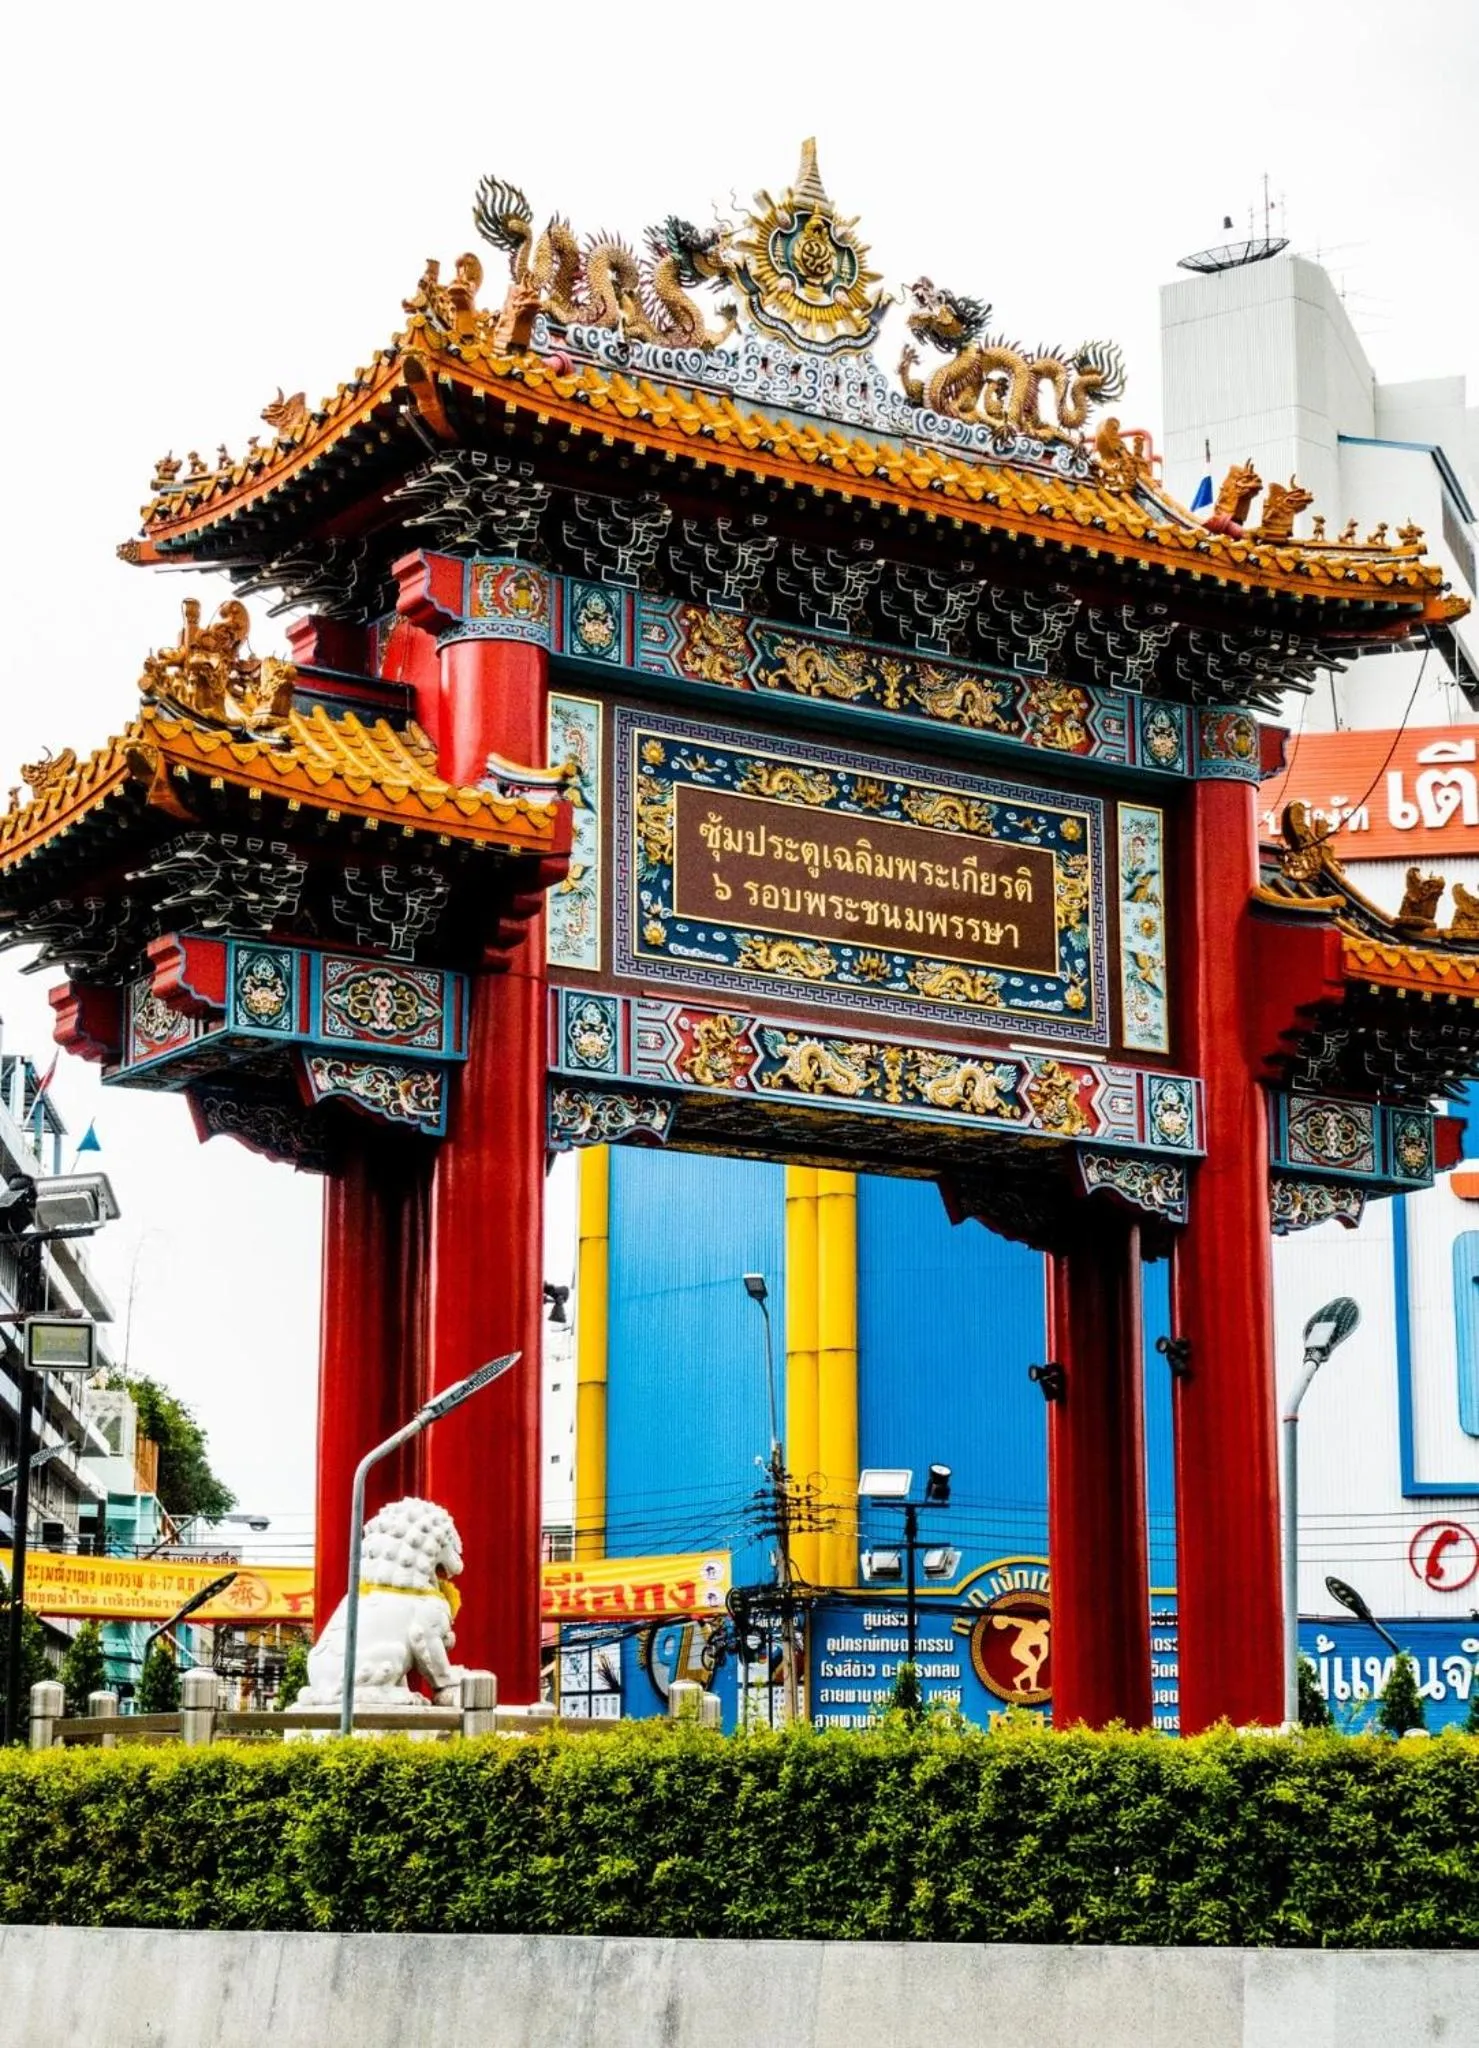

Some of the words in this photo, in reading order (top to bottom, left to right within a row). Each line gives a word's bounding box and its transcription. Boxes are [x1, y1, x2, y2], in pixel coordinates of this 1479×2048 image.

[699, 811, 1034, 904] ซุ้มประตูเฉลิมพระเกียรติ
[712, 873, 732, 902] ๖
[743, 880, 1020, 950] รอบพระชนมพรรษา
[826, 1634, 954, 1656] อุปกรณ์เกษตกรรม
